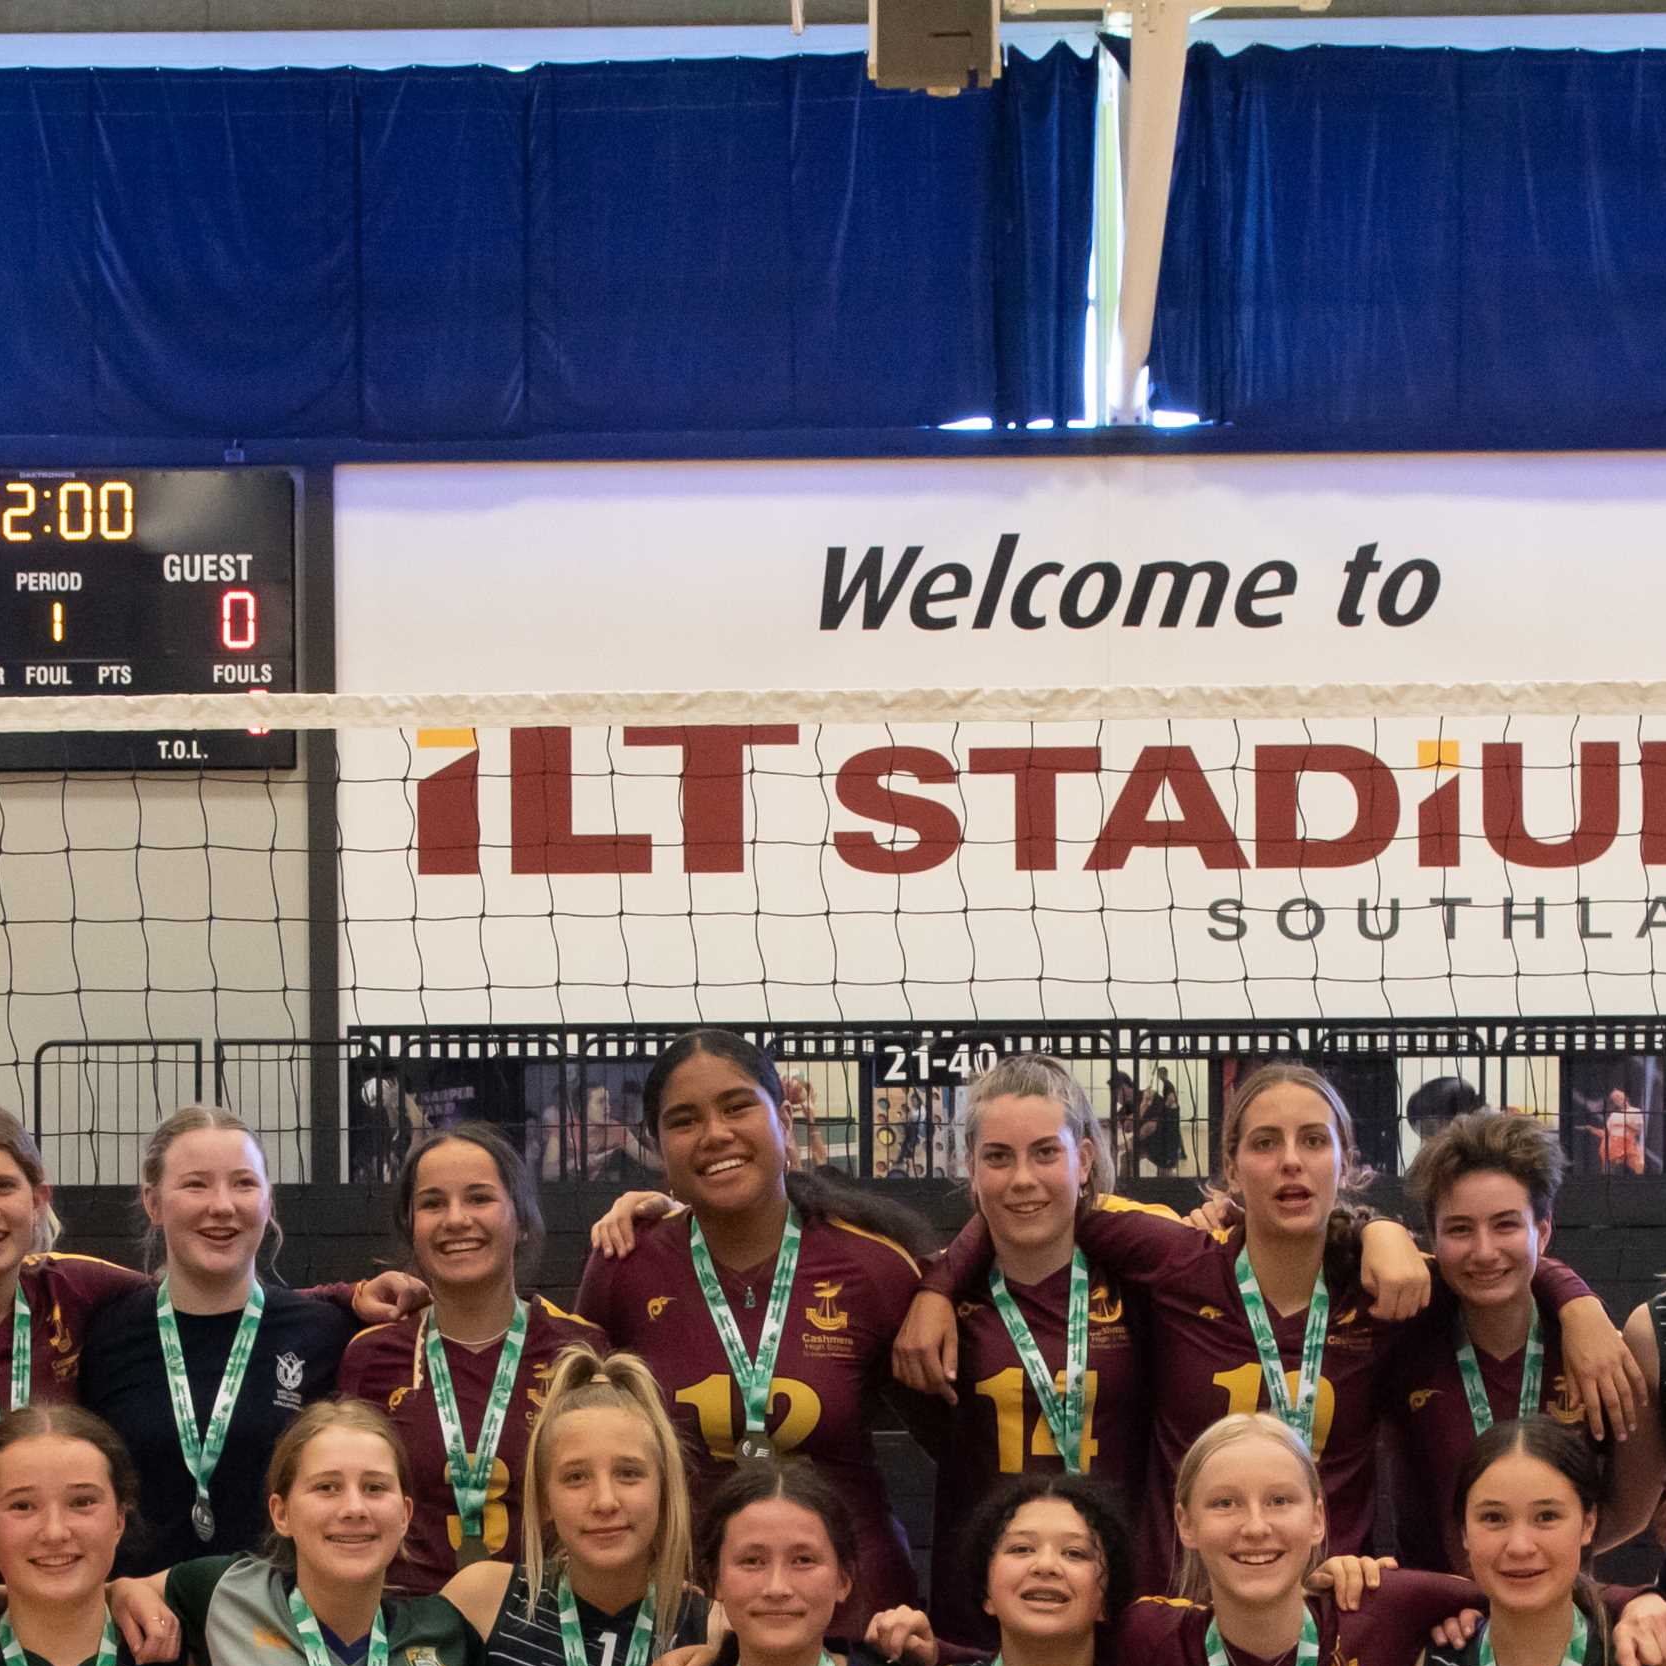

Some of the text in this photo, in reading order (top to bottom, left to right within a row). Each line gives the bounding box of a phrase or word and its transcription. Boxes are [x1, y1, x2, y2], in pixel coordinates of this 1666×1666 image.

[16, 572, 82, 592] PERIOD
[163, 554, 253, 582] GUEST
[819, 533, 1442, 630] Welcome to
[52, 601, 64, 642] 1
[222, 590, 256, 651] 0
[25, 665, 72, 686] FOUL
[98, 665, 132, 685] PTS
[213, 664, 273, 684] FOULS
[158, 740, 208, 760] T.O.L.
[884, 1042, 998, 1081] 21-40
[675, 1373, 822, 1461] 12
[975, 1367, 1099, 1475] 14
